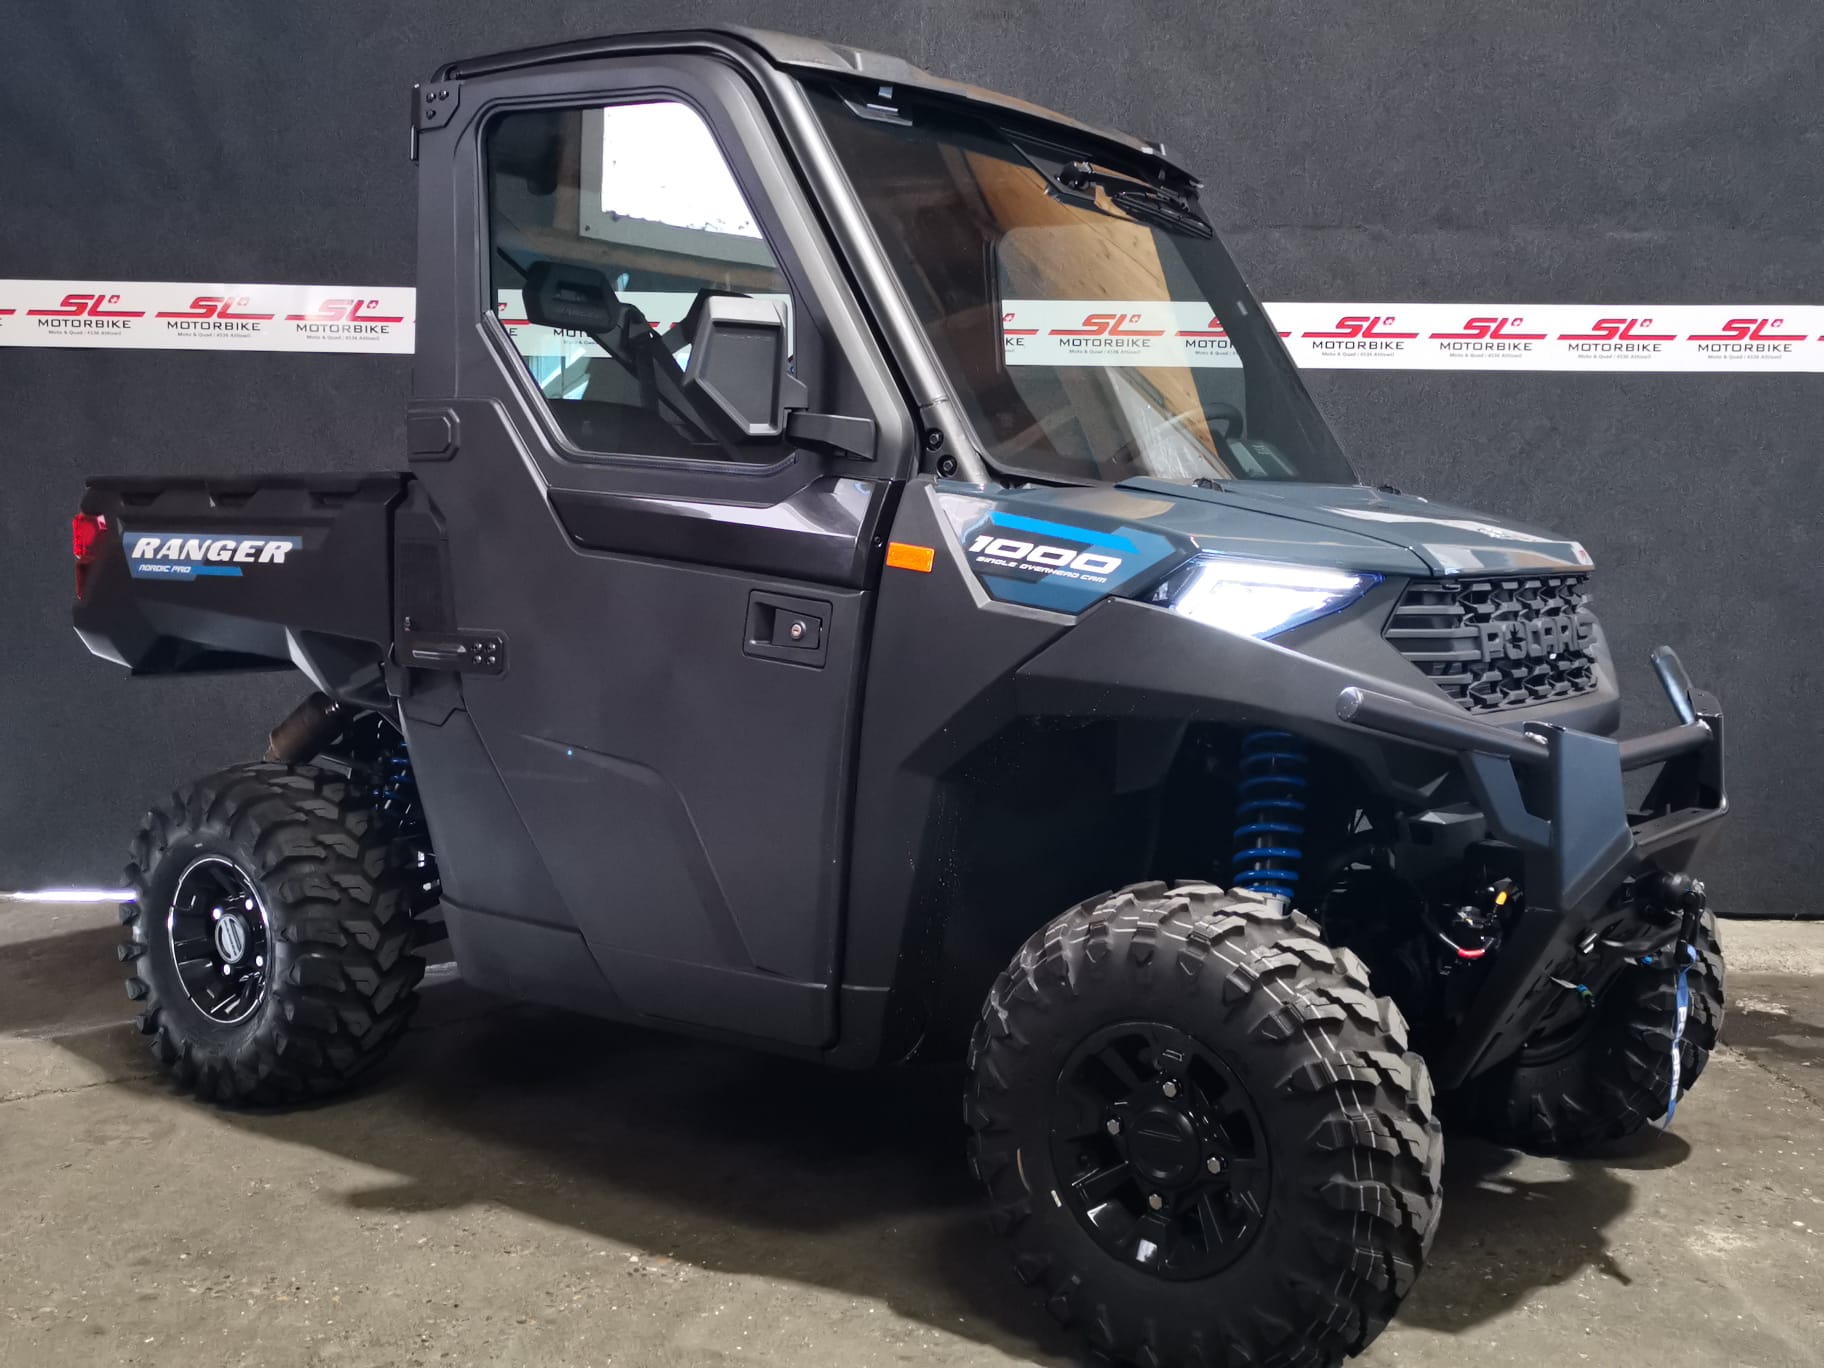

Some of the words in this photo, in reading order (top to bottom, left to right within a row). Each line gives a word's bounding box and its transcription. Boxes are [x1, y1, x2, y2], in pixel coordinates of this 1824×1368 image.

[38, 318, 131, 329] MOTORBIKE
[168, 320, 261, 331] MOTORBIKE
[296, 323, 389, 333] MOTORBIKE
[1060, 338, 1151, 348] MOTORBIKE
[1312, 341, 1404, 350] MOTORBIKE
[1440, 342, 1532, 351] MOTORBIKE
[1568, 343, 1662, 352] MOTORBIKE
[1698, 343, 1792, 353] MOTORBIKE
[131, 537, 293, 563] RANGER
[968, 535, 1122, 575] 1000
[139, 564, 171, 573] NORDIC
[171, 565, 191, 574] PRO
[976, 556, 1018, 568] SINGLE
[1019, 563, 1081, 578] OVERHEAD
[1080, 574, 1108, 584] CAM
